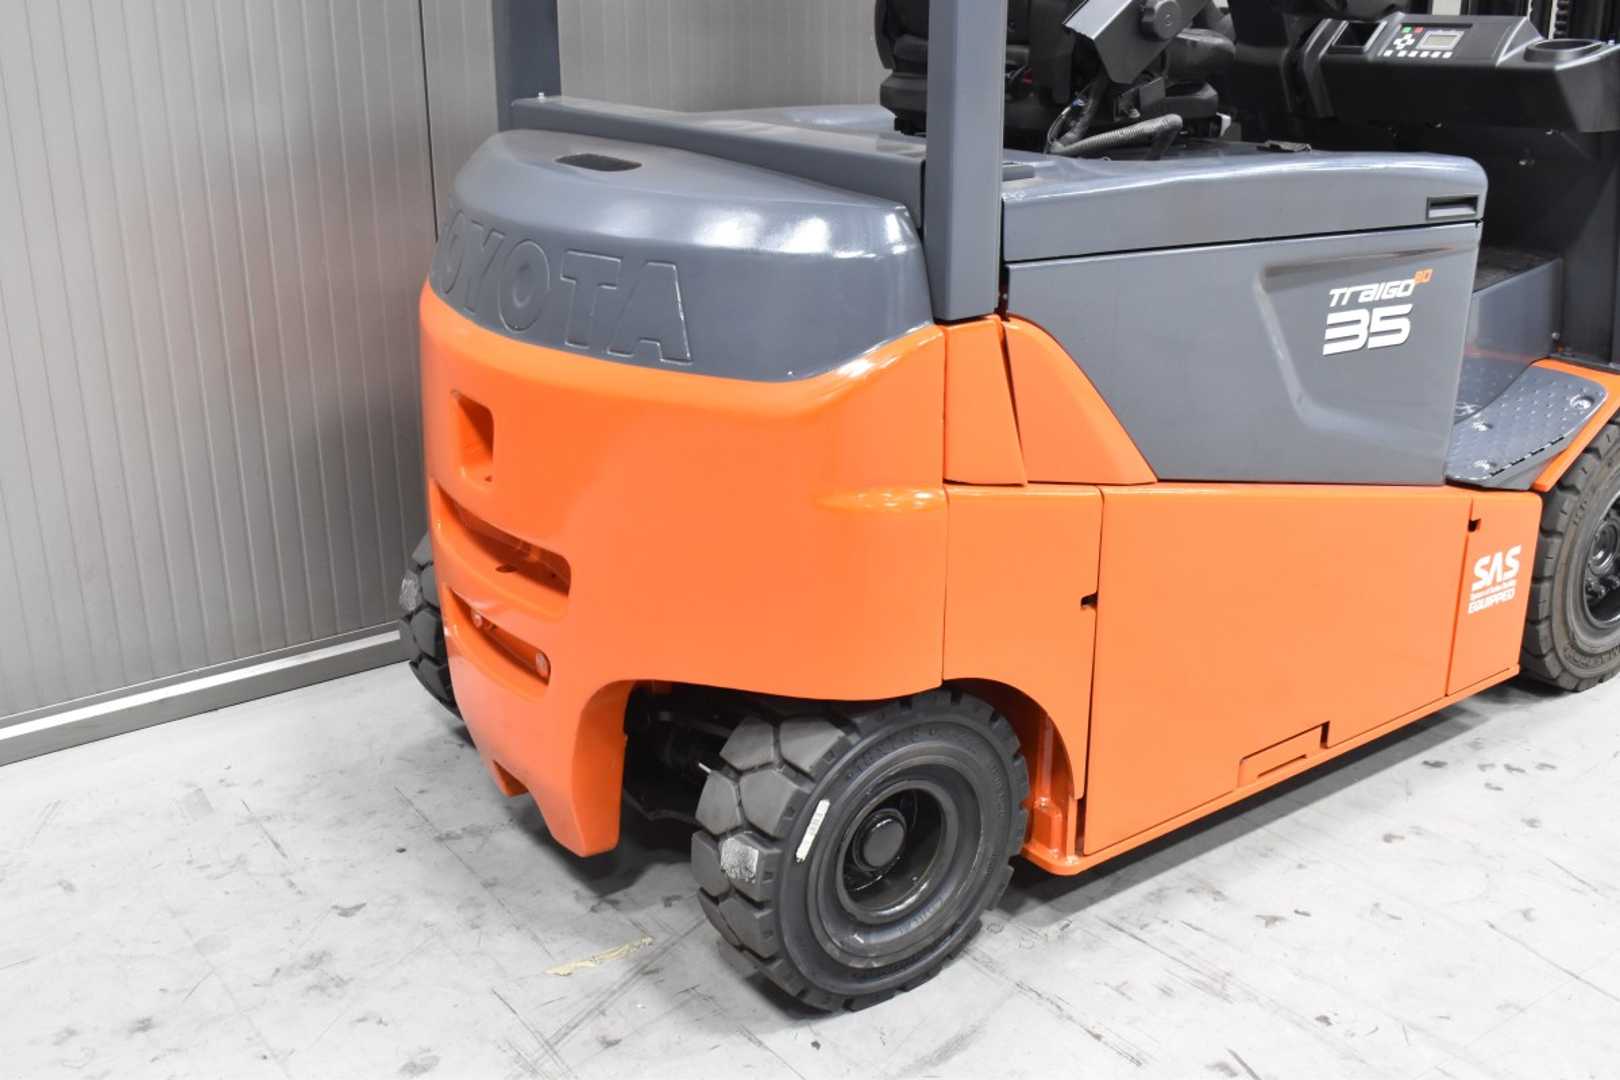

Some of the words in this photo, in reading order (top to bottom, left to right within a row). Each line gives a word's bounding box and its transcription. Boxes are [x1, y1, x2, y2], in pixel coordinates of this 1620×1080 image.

[431, 209, 693, 366] OYOTA
[1322, 303, 1413, 356] 35
[1471, 544, 1521, 592] SAS
